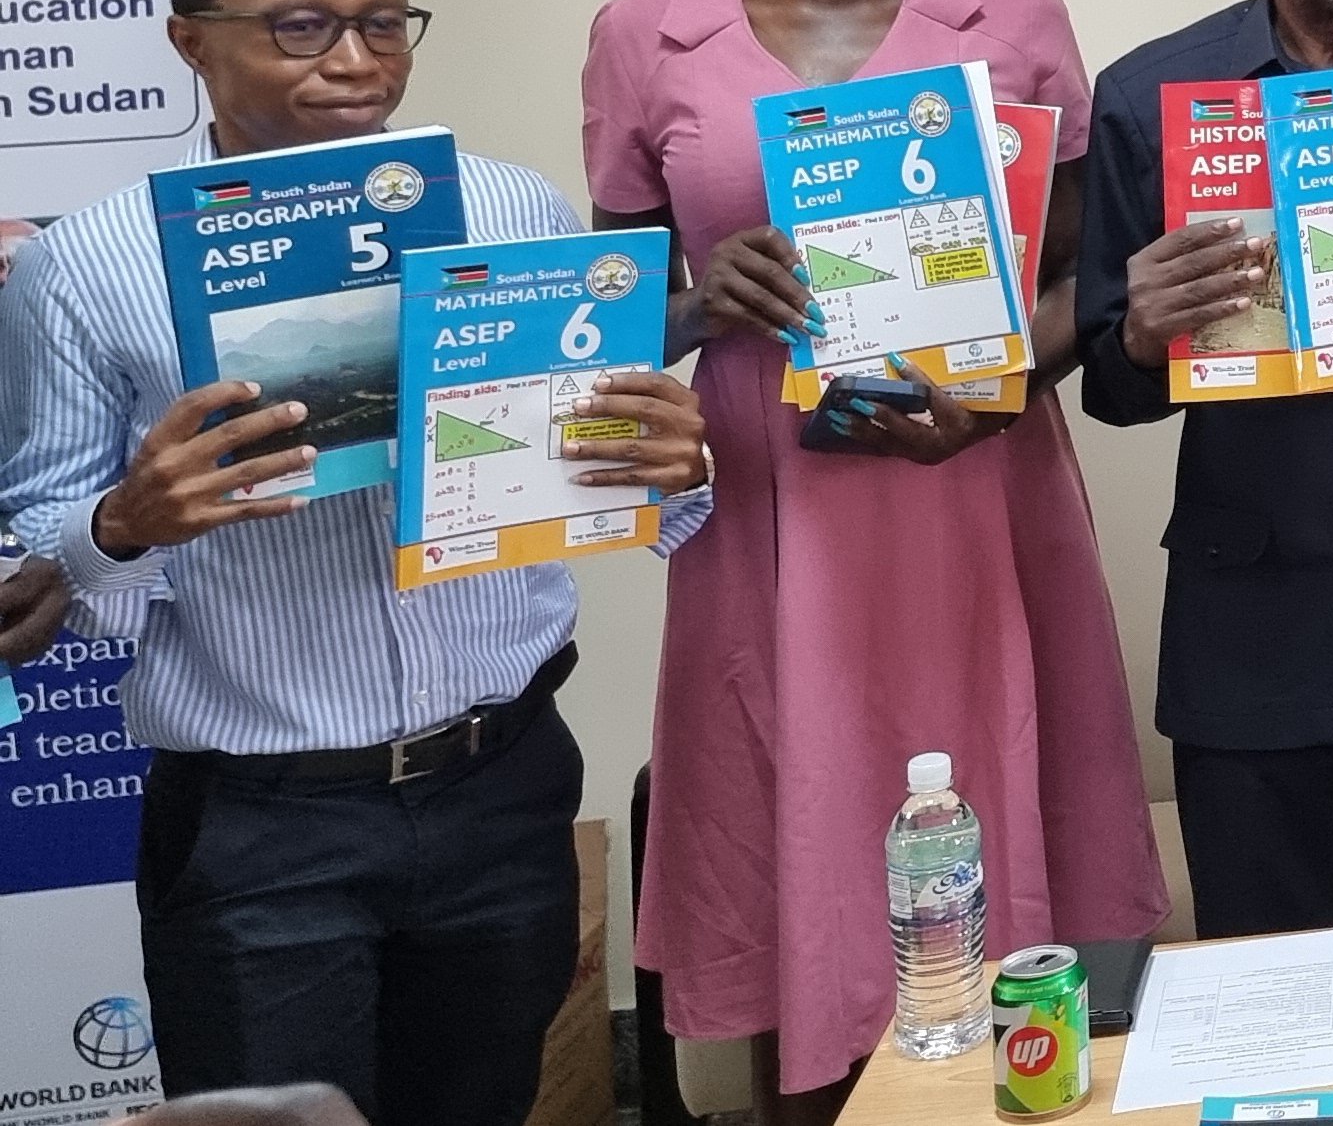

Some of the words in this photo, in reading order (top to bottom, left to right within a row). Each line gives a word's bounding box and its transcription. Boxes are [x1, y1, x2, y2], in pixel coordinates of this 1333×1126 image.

[28, 83, 166, 117] Sudan
[833, 112, 865, 126] South
[867, 108, 900, 120] Sudan
[1241, 109, 1264, 119] Sou
[785, 121, 910, 154] MATHEMATICS
[1190, 125, 1267, 144] HISTOR
[791, 158, 860, 188] ASEP
[901, 138, 937, 195] 6
[1190, 154, 1262, 176] ASEP
[261, 186, 304, 202] South
[308, 180, 352, 195] Sudan
[794, 188, 842, 210] Level
[1191, 181, 1238, 197] Level
[196, 194, 361, 235] GEOGRAPHY
[1298, 205, 1333, 218] Finding
[795, 223, 834, 238] Finding
[836, 219, 862, 231] side:
[202, 237, 293, 272] ASEP
[348, 221, 391, 273] 5
[205, 271, 267, 296] Level
[495, 272, 534, 285] South
[537, 268, 576, 281] Sudan
[434, 283, 584, 313] MATHEMATICS
[433, 320, 516, 350] ASEP
[560, 301, 602, 361] 6
[433, 352, 488, 373] Level
[427, 388, 471, 402] Finding
[474, 384, 502, 396] side:
[21, 638, 139, 672] xpan
[11, 773, 144, 807] enhan
[0, 1084, 86, 1111] WORLD
[91, 1075, 157, 1099] BANK
